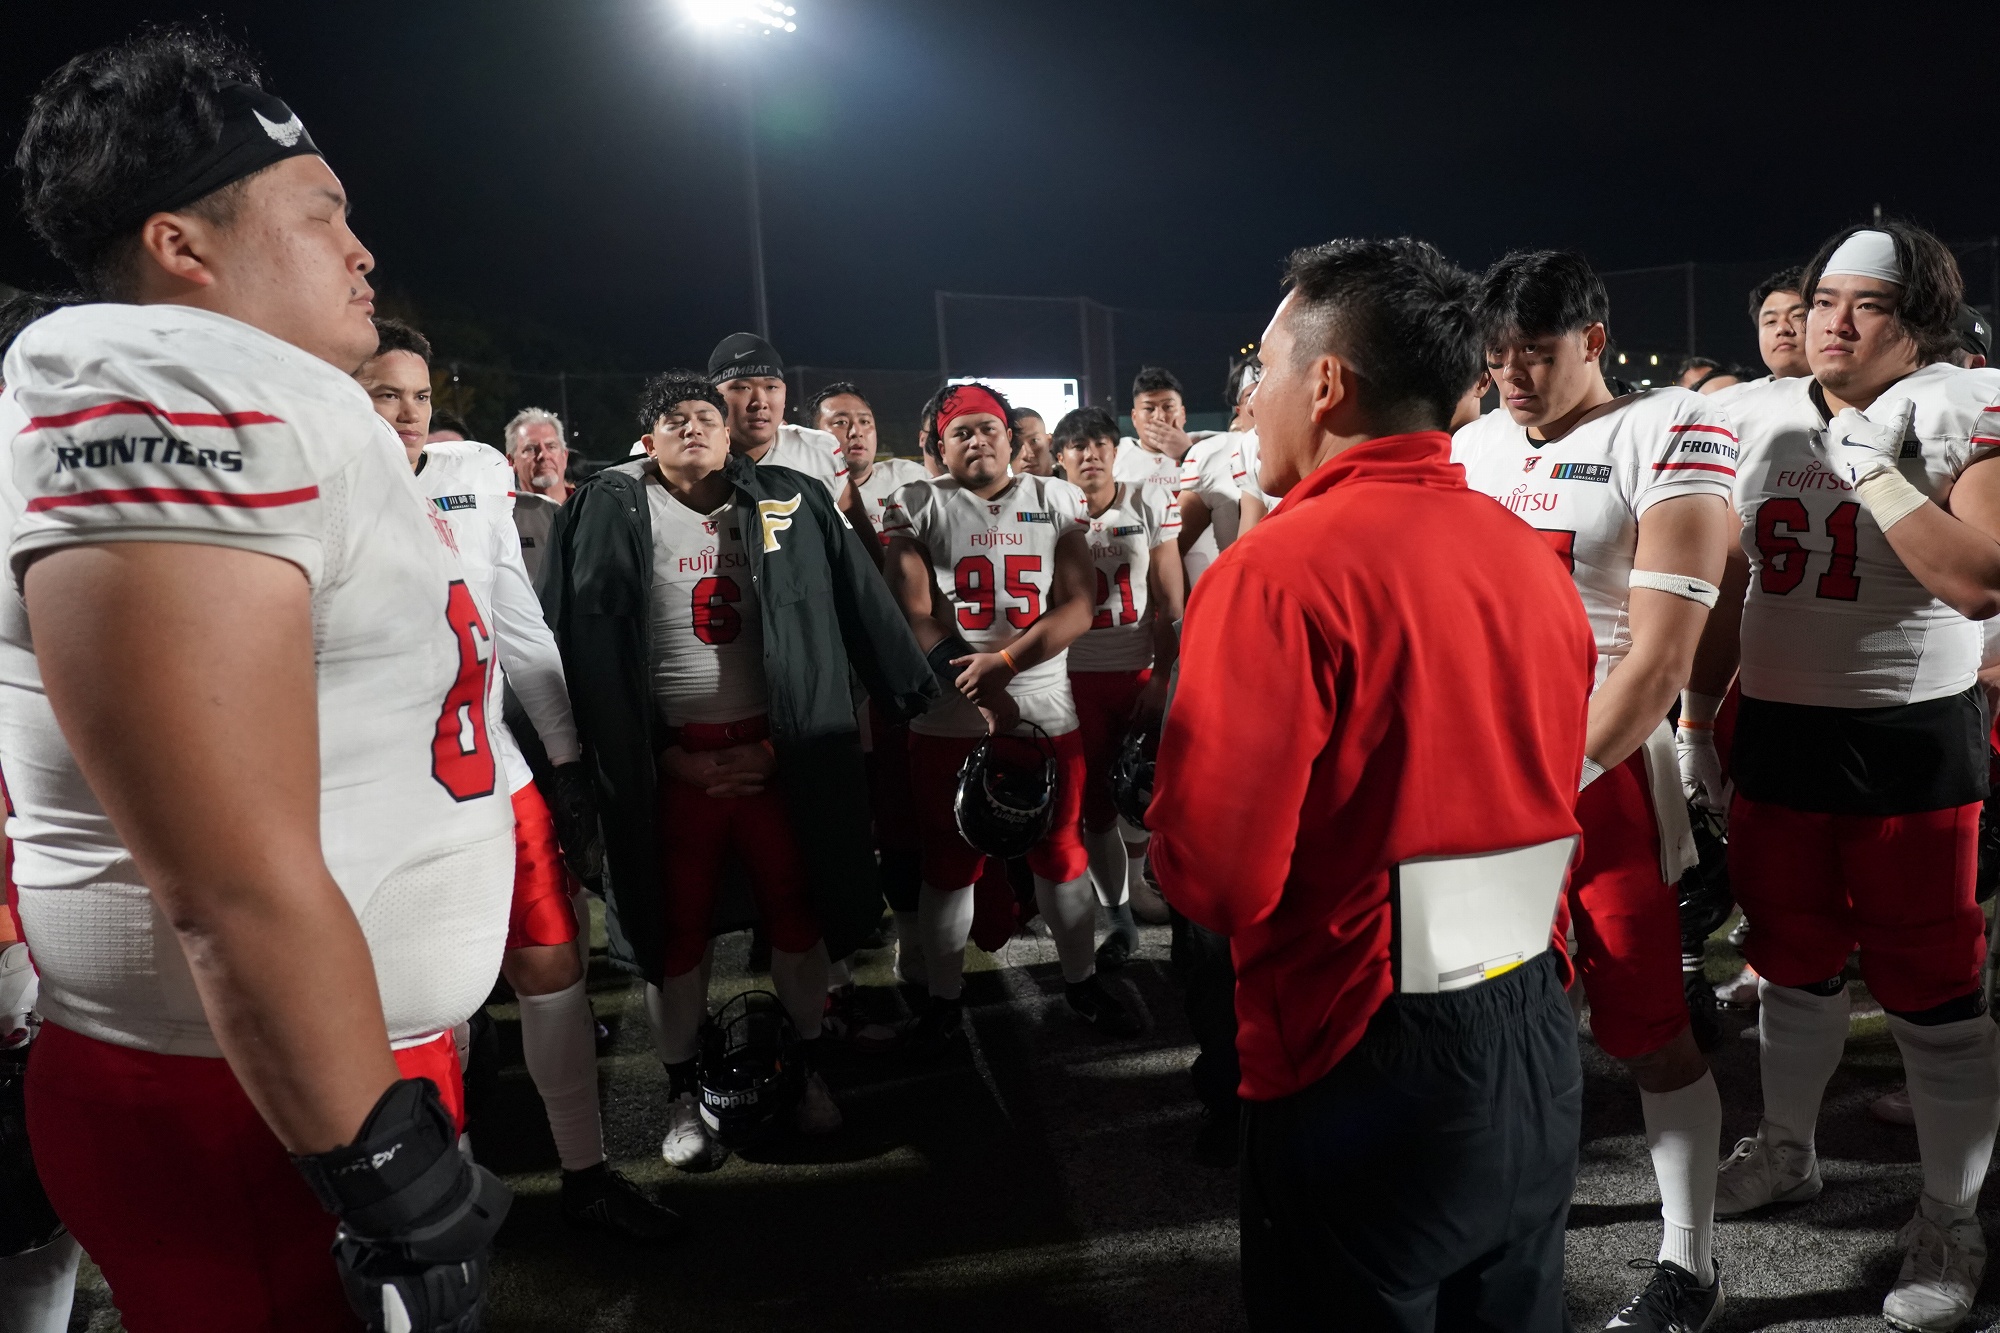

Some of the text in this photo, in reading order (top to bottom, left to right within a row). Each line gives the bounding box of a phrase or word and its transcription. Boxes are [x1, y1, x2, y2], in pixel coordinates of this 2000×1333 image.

[722, 365, 770, 380] COMBAT
[56, 433, 242, 473] RONTIERS
[1680, 441, 1738, 460] FRONTIER
[1574, 464, 1610, 476] 川崎市
[970, 525, 1023, 549] FUJITSU
[1755, 497, 1862, 602] 61
[678, 546, 747, 575] FUJITSU
[954, 554, 1042, 631] 95
[691, 575, 742, 646] 6
[704, 1090, 759, 1109] Riddell
